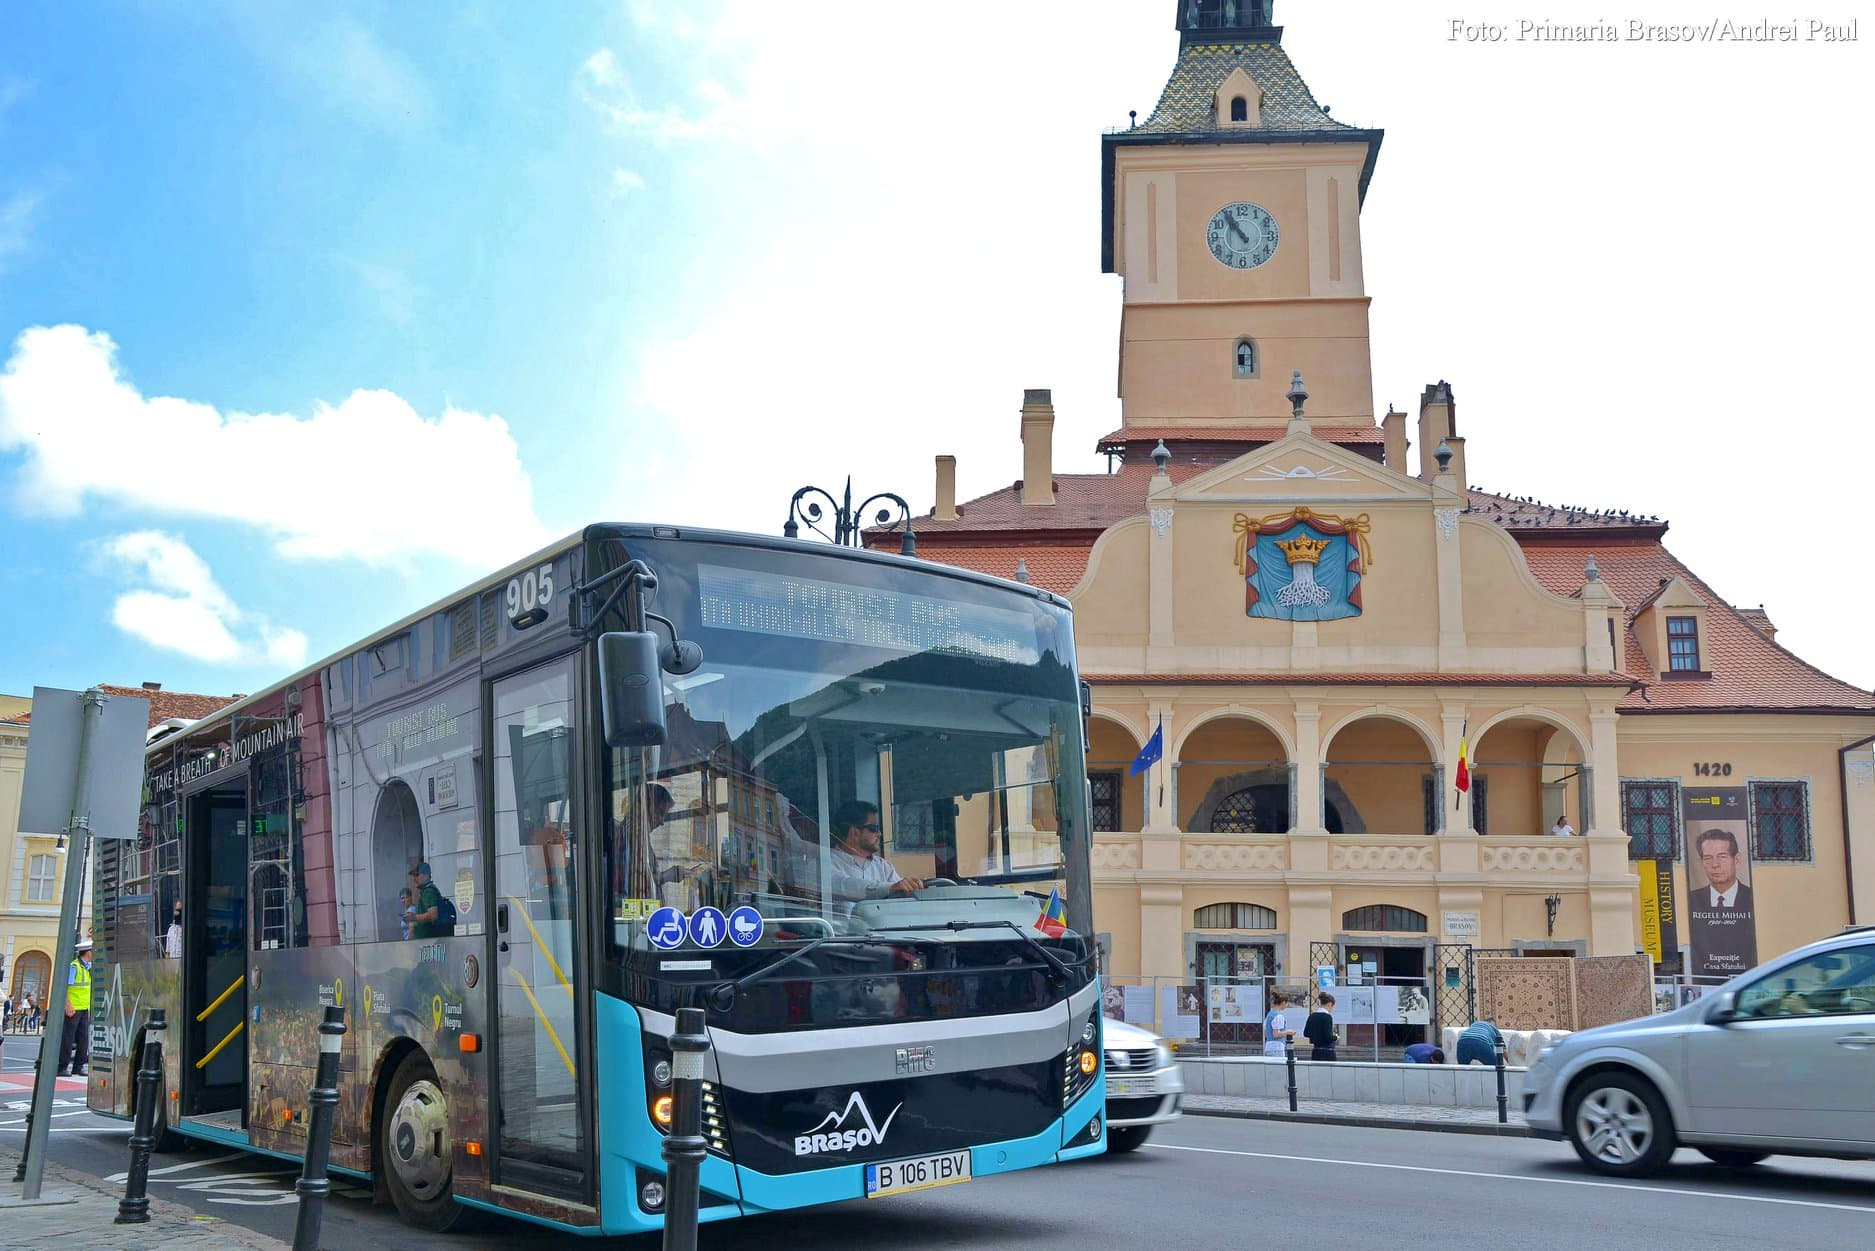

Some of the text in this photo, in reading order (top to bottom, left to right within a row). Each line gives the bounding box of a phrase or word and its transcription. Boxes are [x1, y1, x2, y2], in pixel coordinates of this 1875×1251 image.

[507, 563, 553, 617] 905
[912, 601, 960, 629] BUS
[155, 772, 173, 792] TAKE
[174, 768, 179, 785] A
[181, 758, 211, 783] BREATH
[232, 723, 284, 763] MOUNTAIN
[286, 713, 305, 739] AIR
[1693, 762, 1732, 776] 1420
[1659, 872, 1673, 923] HISTORY
[1644, 899, 1657, 951] MUSEUM
[1692, 911, 1719, 919] REGELE
[1722, 911, 1747, 919] MIHAI
[444, 1003, 462, 1014] Turnul
[444, 1016, 462, 1030] Negru
[880, 1167, 893, 1188] B
[900, 1162, 926, 1184] 106
[930, 1155, 964, 1179] TBV
